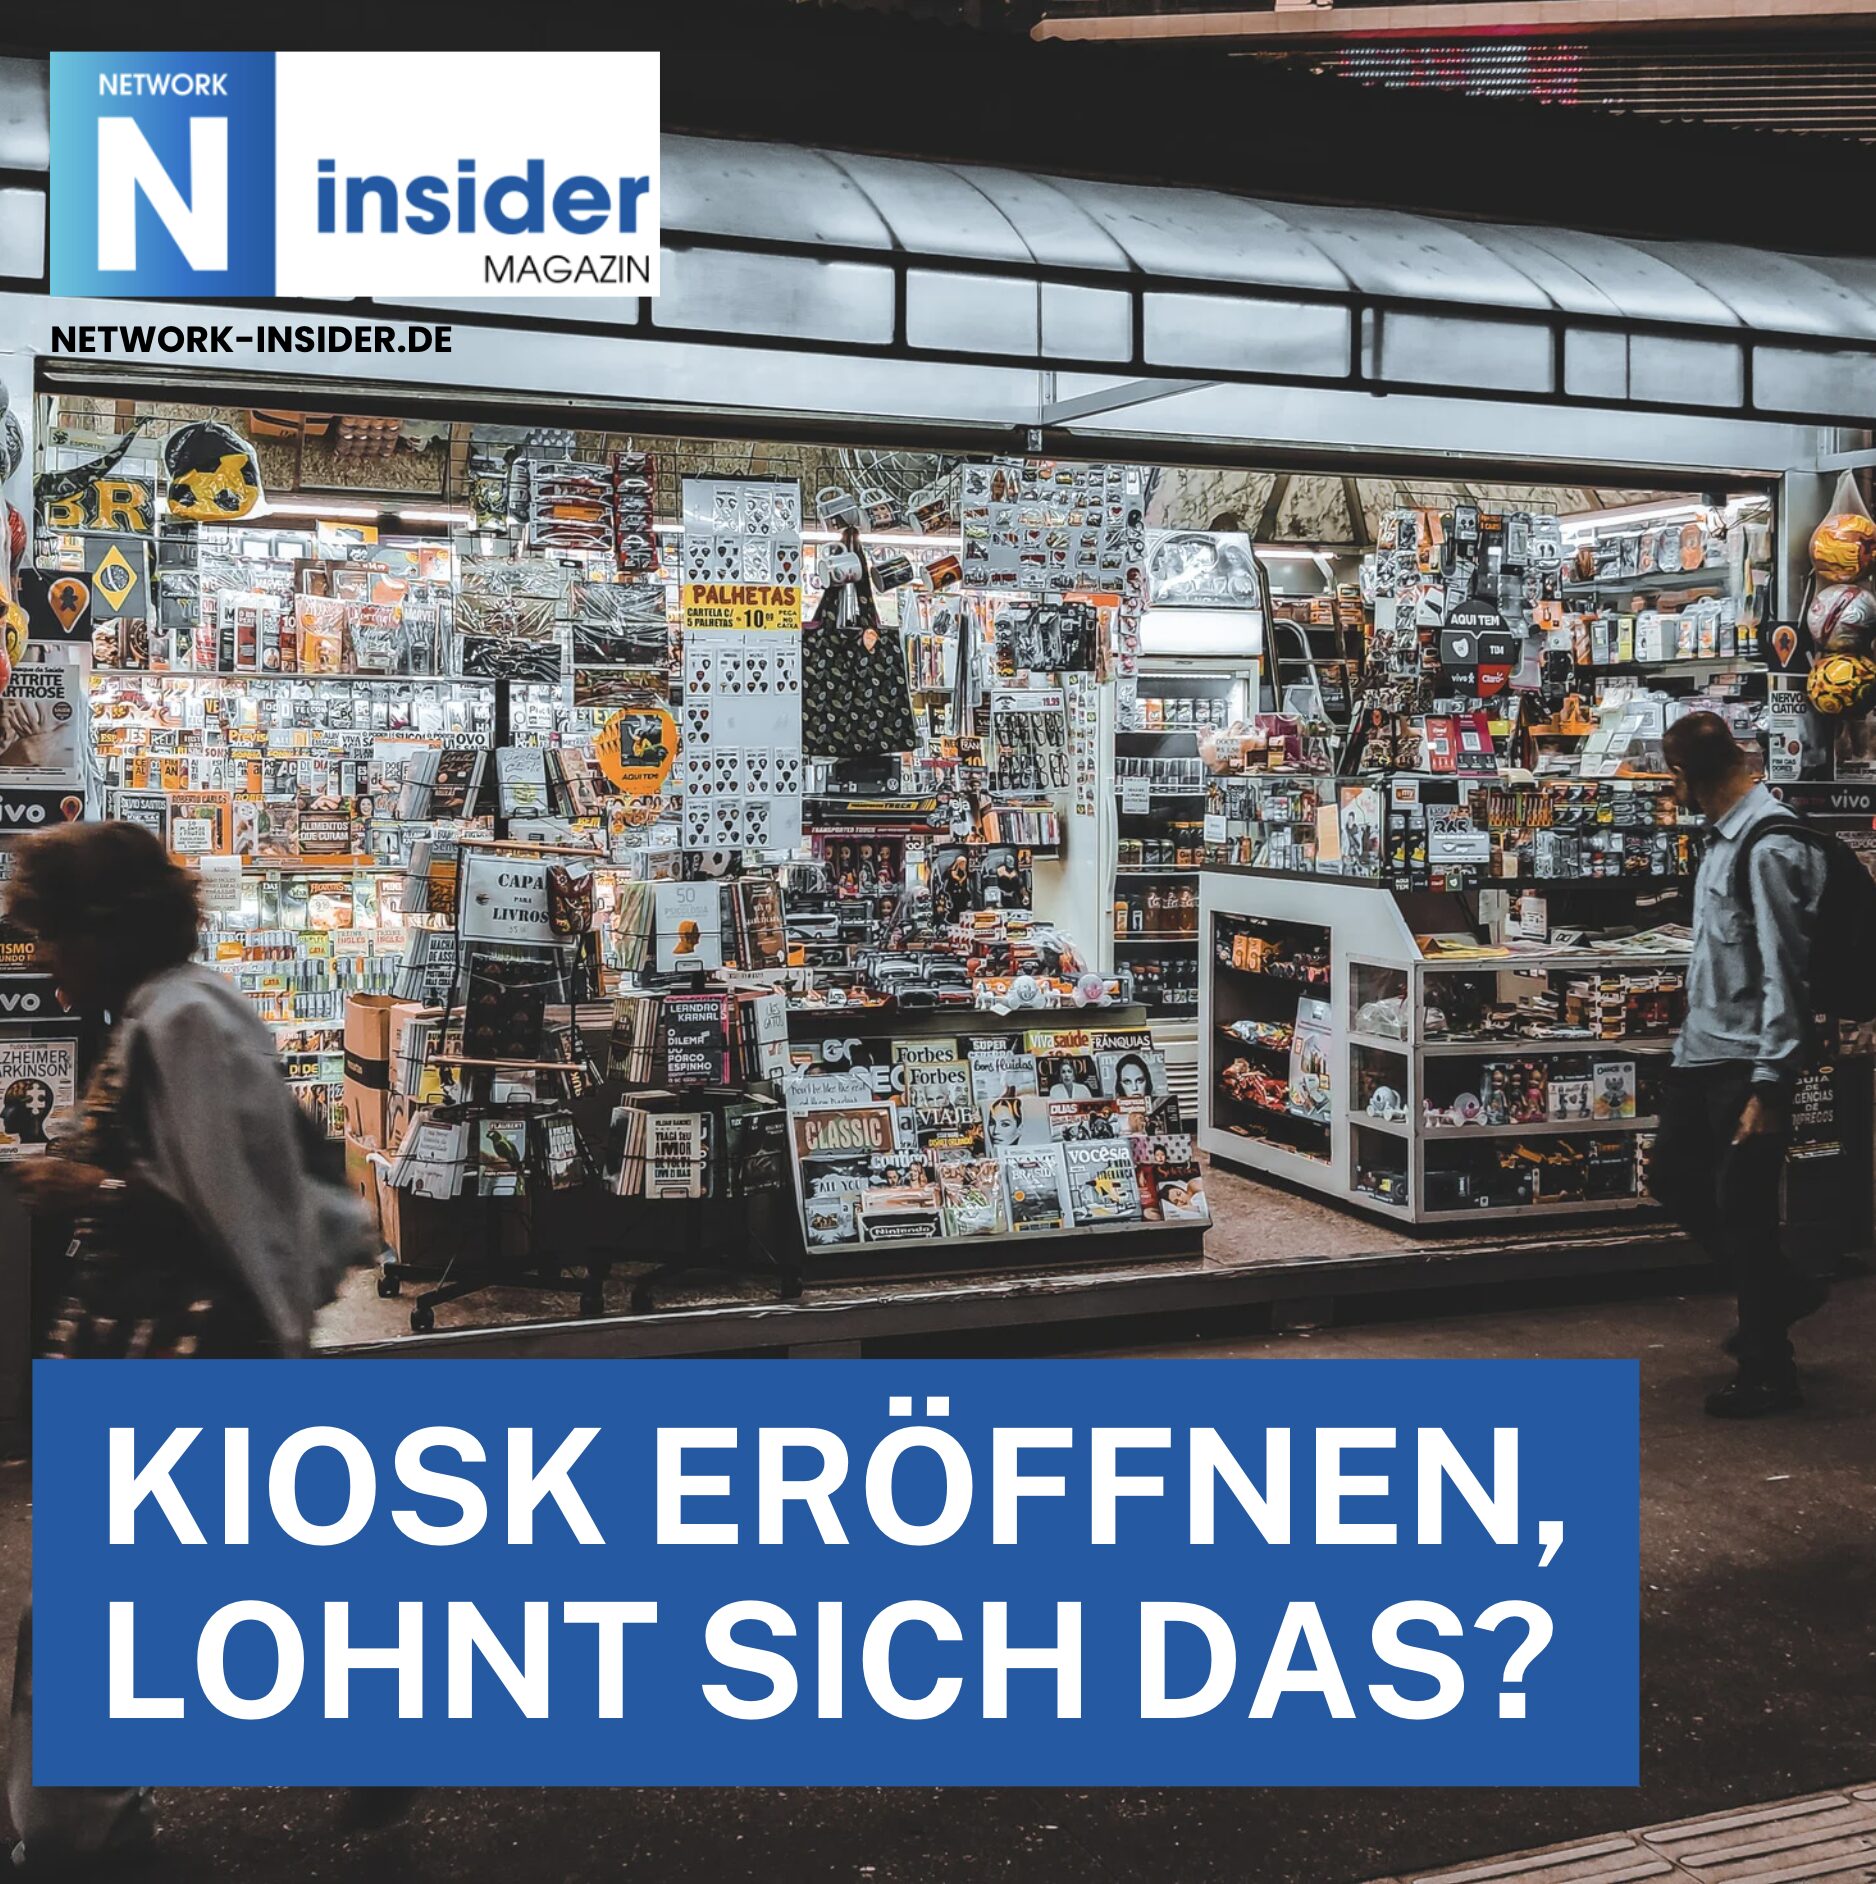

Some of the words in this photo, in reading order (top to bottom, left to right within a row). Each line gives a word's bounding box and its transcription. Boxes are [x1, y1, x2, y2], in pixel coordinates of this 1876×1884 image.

[692, 584, 796, 606] PALHETAS
[687, 607, 723, 617] CARTELA
[724, 607, 734, 617] C/
[687, 618, 693, 627] 5
[694, 618, 734, 628] PALHETAS
[1450, 613, 1476, 626] AQUI
[1478, 614, 1500, 626] TEM
[1489, 645, 1504, 655] TIM
[9, 673, 63, 687] RTRITE
[1771, 692, 1803, 703] NERVO
[456, 732, 485, 745] OVO
[1831, 788, 1871, 809] vivo
[301, 821, 349, 832] ALIMENTOS
[300, 832, 317, 841] QUE
[317, 832, 349, 841] CURAM
[498, 873, 545, 890] CAPA
[513, 896, 532, 904] PARA
[676, 887, 696, 904] 50
[492, 907, 550, 924] LIVROS
[670, 1003, 719, 1012] LEANDRO
[677, 1012, 719, 1021] KARNAL
[667, 1028, 676, 1037] O
[667, 1036, 705, 1046] DILEMA
[972, 1039, 1008, 1050] SUPER
[667, 1053, 705, 1063] PORCO
[896, 1047, 954, 1064] Forbes
[667, 1062, 713, 1072] ESPINHO
[910, 1068, 966, 1086] Forbes
[1050, 1105, 1079, 1114] DUAS
[490, 1122, 524, 1130] FLAUBERT
[804, 1117, 882, 1150] CLASSIC
[655, 1143, 692, 1156] AMOR
[874, 1225, 930, 1236] Nintendo
